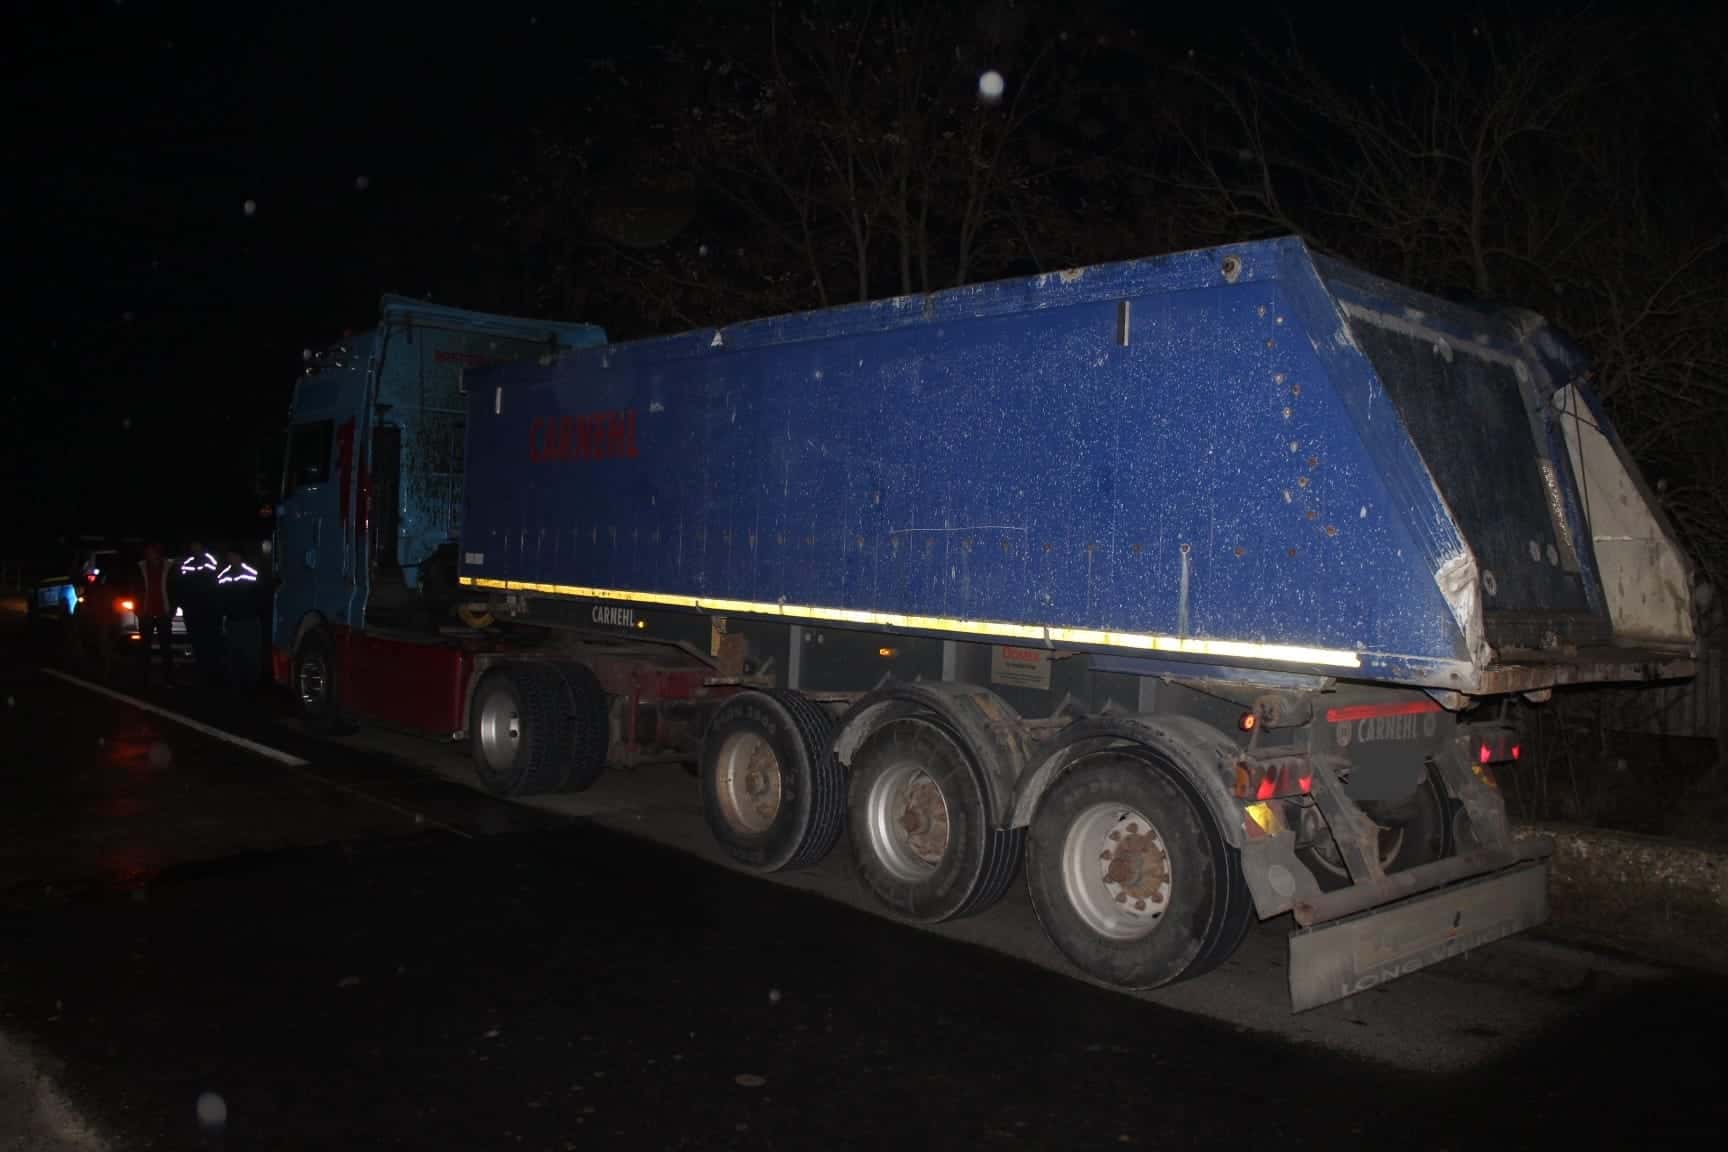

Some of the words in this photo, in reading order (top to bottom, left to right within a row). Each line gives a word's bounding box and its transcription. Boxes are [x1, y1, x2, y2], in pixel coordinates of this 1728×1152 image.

[529, 410, 639, 464] CARNEHL
[592, 605, 634, 627] CARNEHL
[1358, 713, 1418, 743] CARNEHL
